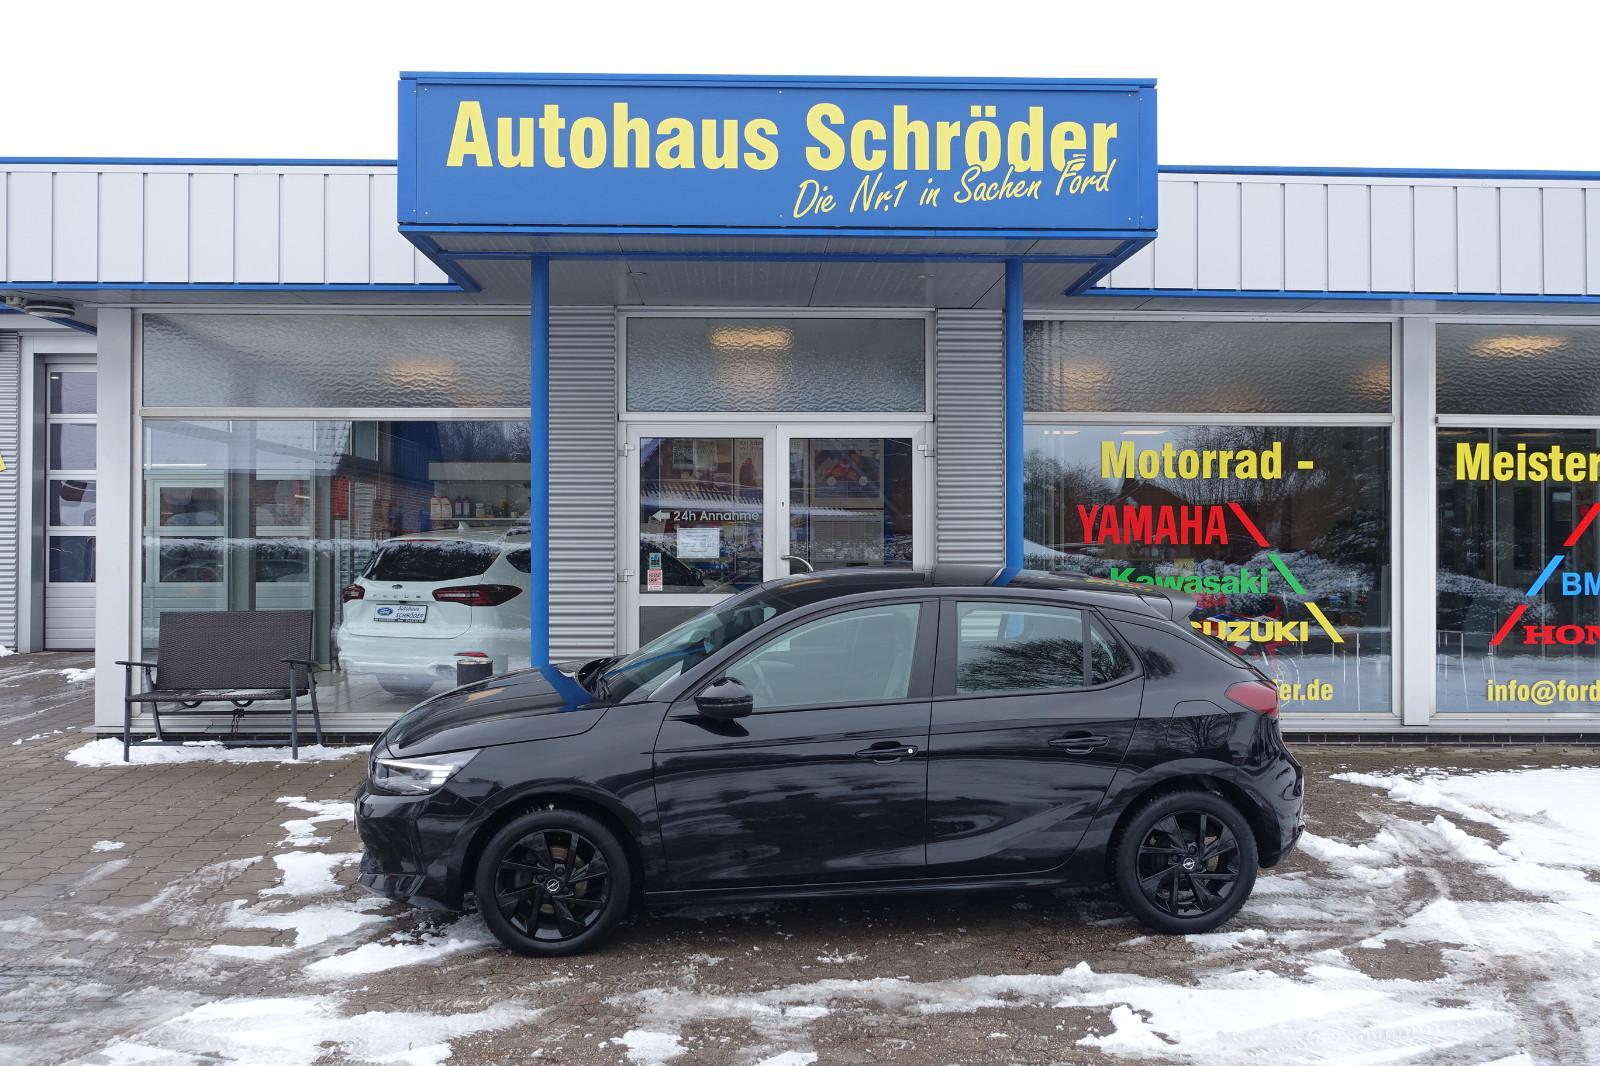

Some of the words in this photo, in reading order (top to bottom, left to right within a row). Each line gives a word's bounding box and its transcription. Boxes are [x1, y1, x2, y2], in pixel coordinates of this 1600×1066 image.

[446, 100, 779, 171] Autohaus
[805, 102, 1118, 173] Schröder
[793, 179, 837, 219] Die
[919, 178, 942, 207] in
[953, 165, 1042, 204] Sachen
[1055, 154, 1117, 196] Ford
[1100, 440, 1283, 480] Motorrad
[1456, 442, 1600, 482] Meister
[673, 510, 697, 521] 24h
[699, 510, 760, 521] Annahme
[1077, 504, 1229, 545] YAMAHA
[1271, 679, 1334, 701] er.de
[1487, 679, 1600, 706] info@ford
